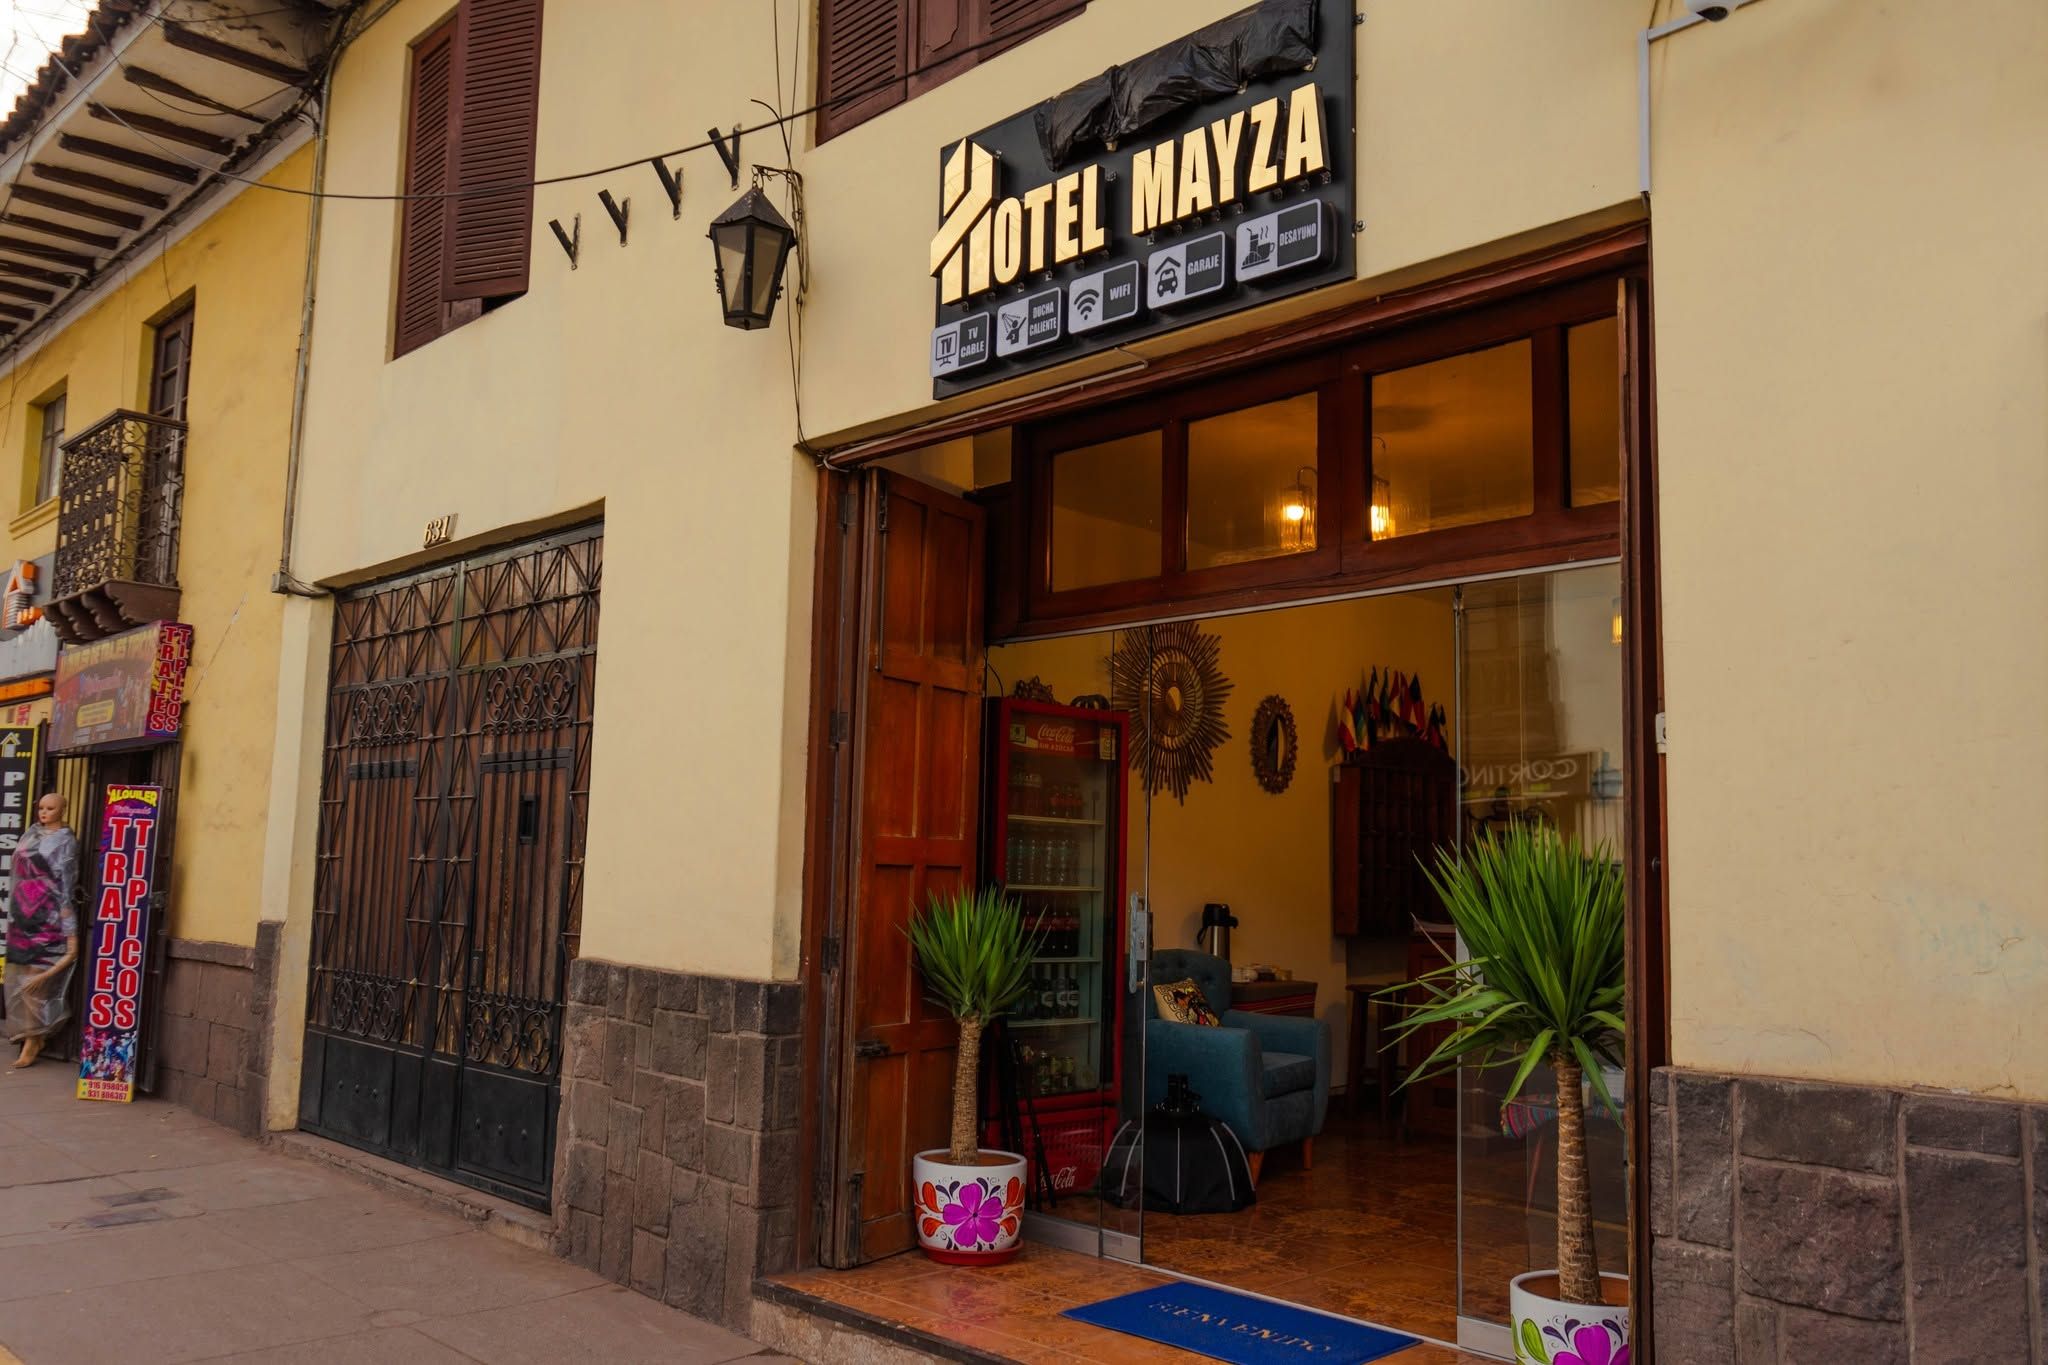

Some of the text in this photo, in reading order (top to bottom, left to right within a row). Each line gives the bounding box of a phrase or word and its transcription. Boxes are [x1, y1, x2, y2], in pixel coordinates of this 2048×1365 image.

[930, 82, 1326, 304] HOTEL MAYZA
[1279, 223, 1317, 247] DESAYUNO
[1187, 254, 1220, 275] GARAJE
[1109, 283, 1131, 300] WIFI
[1032, 301, 1054, 318] DUCHA
[967, 327, 979, 341] TV
[1029, 317, 1057, 336] CALIENTE
[940, 337, 953, 354] TV
[960, 341, 985, 358] CABLE
[424, 515, 451, 544] 631
[150, 626, 178, 731] TRAJES
[165, 629, 191, 733] TIPICOS
[108, 789, 157, 807] ALQUILER
[90, 817, 131, 1028] TRAJES
[114, 818, 153, 1029] TIPICOS
